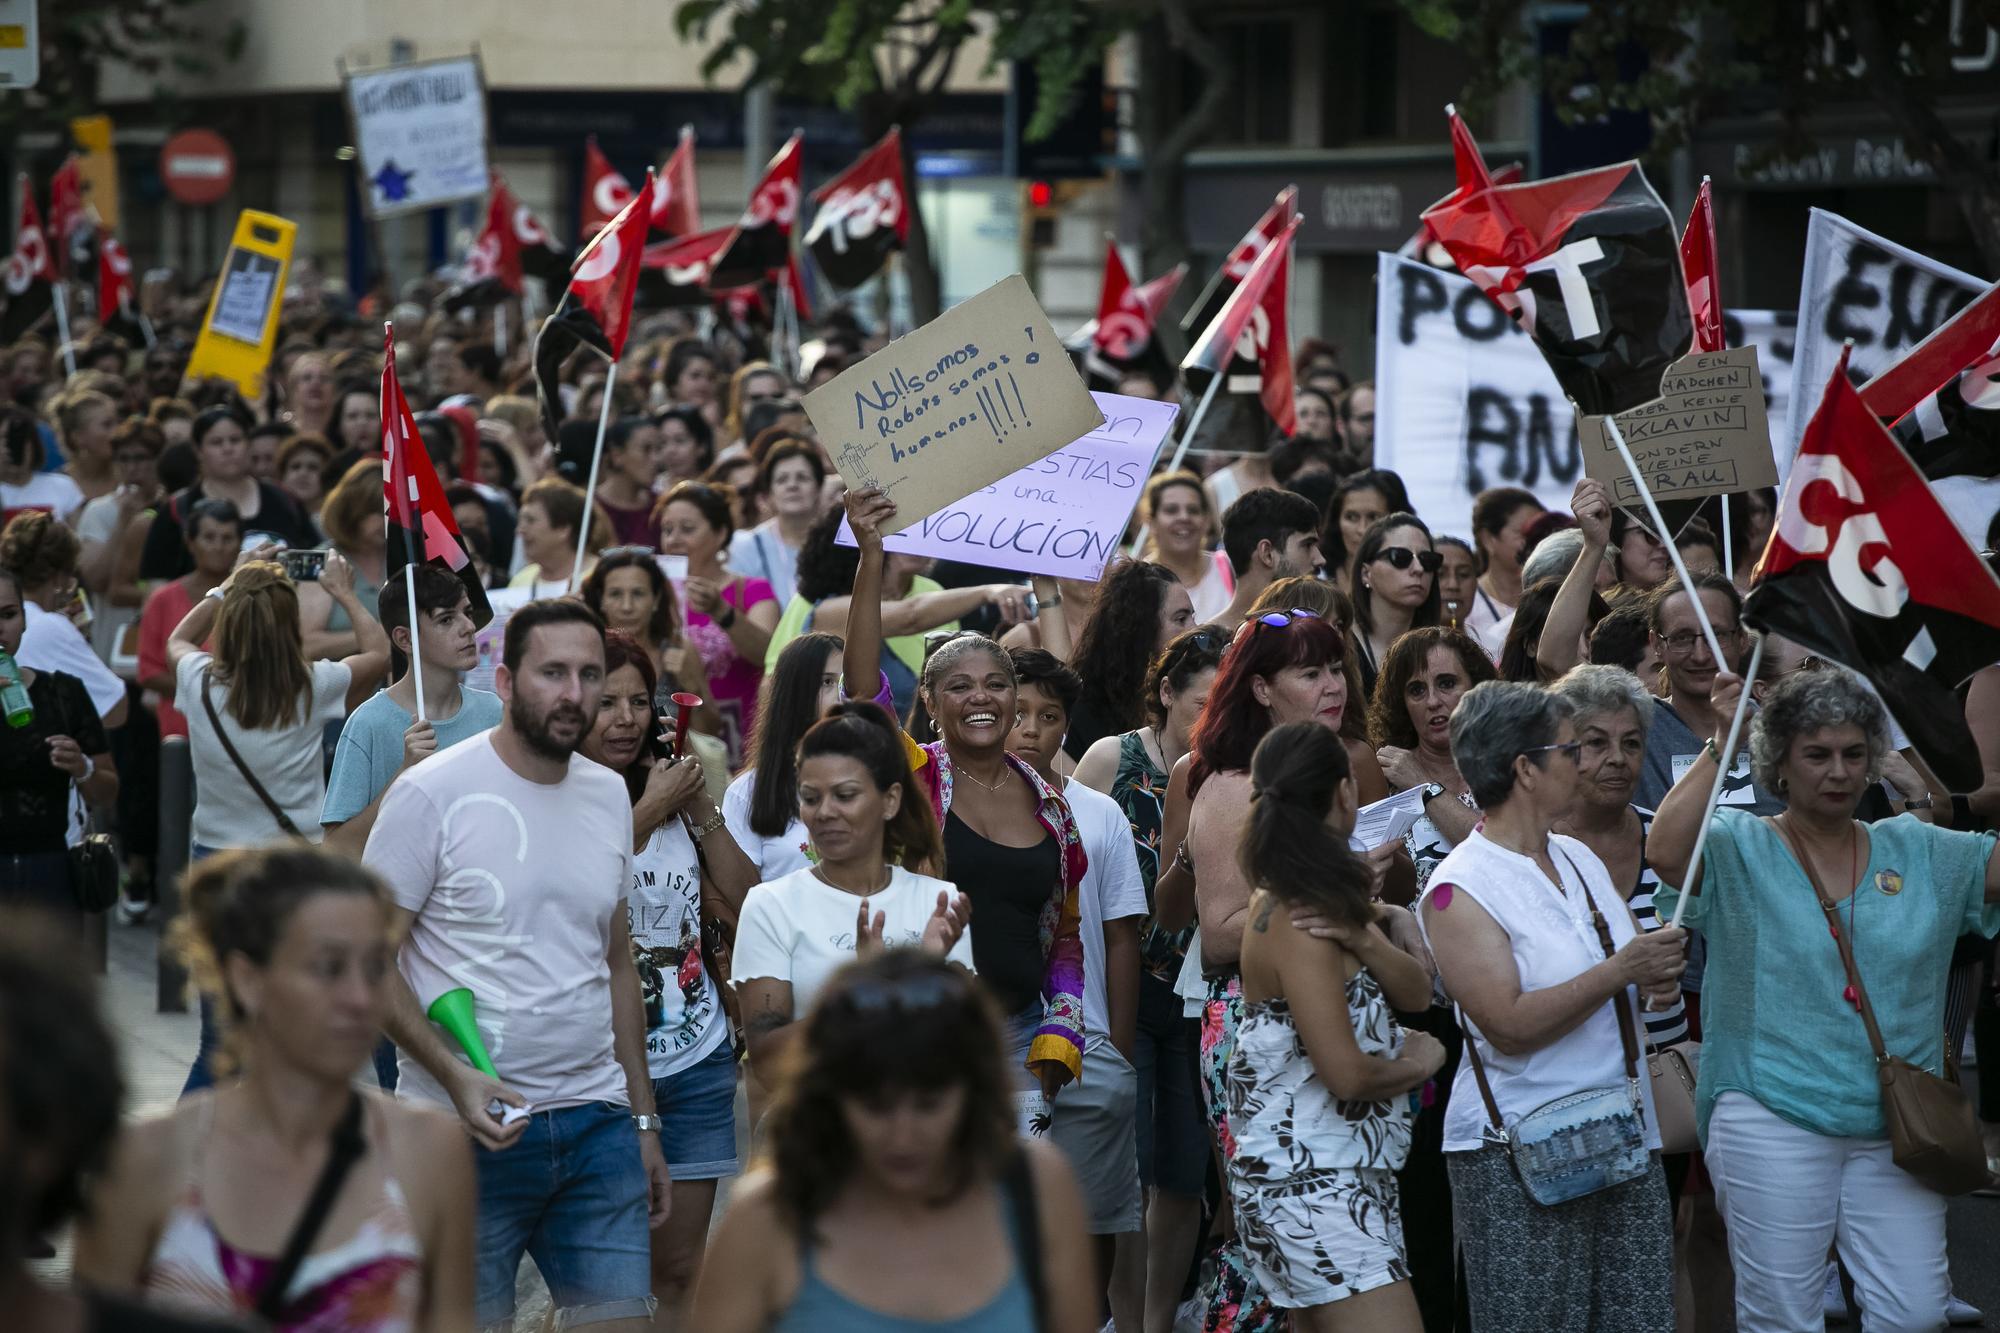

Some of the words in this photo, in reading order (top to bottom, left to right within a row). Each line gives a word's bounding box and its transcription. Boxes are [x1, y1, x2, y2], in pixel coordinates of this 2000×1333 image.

[1398, 264, 1526, 345] PO
[1697, 356, 1728, 368] EIN
[1682, 394, 1742, 408] KEINE
[1634, 437, 1724, 462] ONDERN
[1025, 452, 1140, 489] STIAS
[894, 510, 1118, 561] VOLUCIÓN
